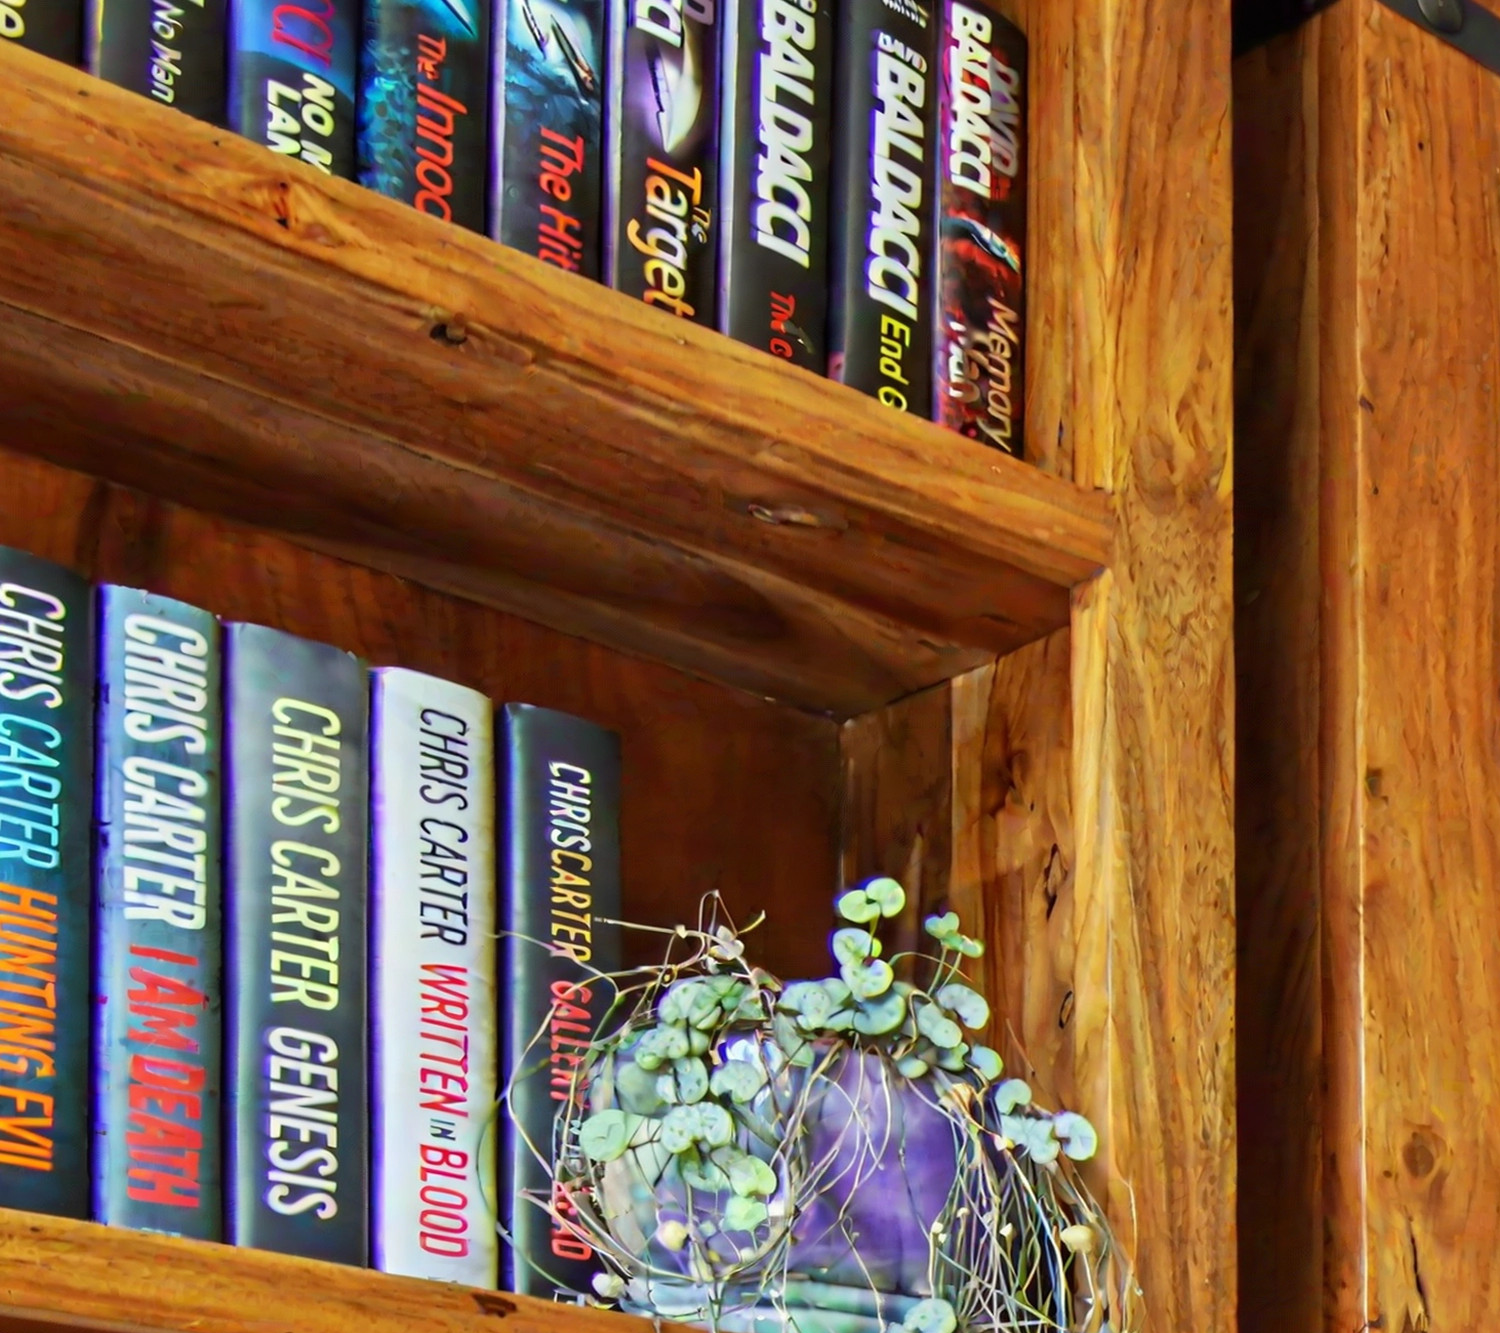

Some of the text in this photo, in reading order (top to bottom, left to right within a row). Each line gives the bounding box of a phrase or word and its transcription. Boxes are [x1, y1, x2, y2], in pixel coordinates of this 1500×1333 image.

[301, 74, 336, 136] NO
[754, 0, 816, 268] BALDACCI
[950, 4, 992, 198] BALDACCI
[627, 158, 702, 317] Target
[976, 297, 1019, 453] Memory
[123, 614, 208, 1208] CHRIS CARTER I AM DEATH
[267, 698, 341, 1220] CHRIS CARTER GENESIS
[549, 760, 592, 962] CHRIS CARTER
[419, 707, 469, 1260] CHRIS CARTER WRITTEN IN BLOOD
